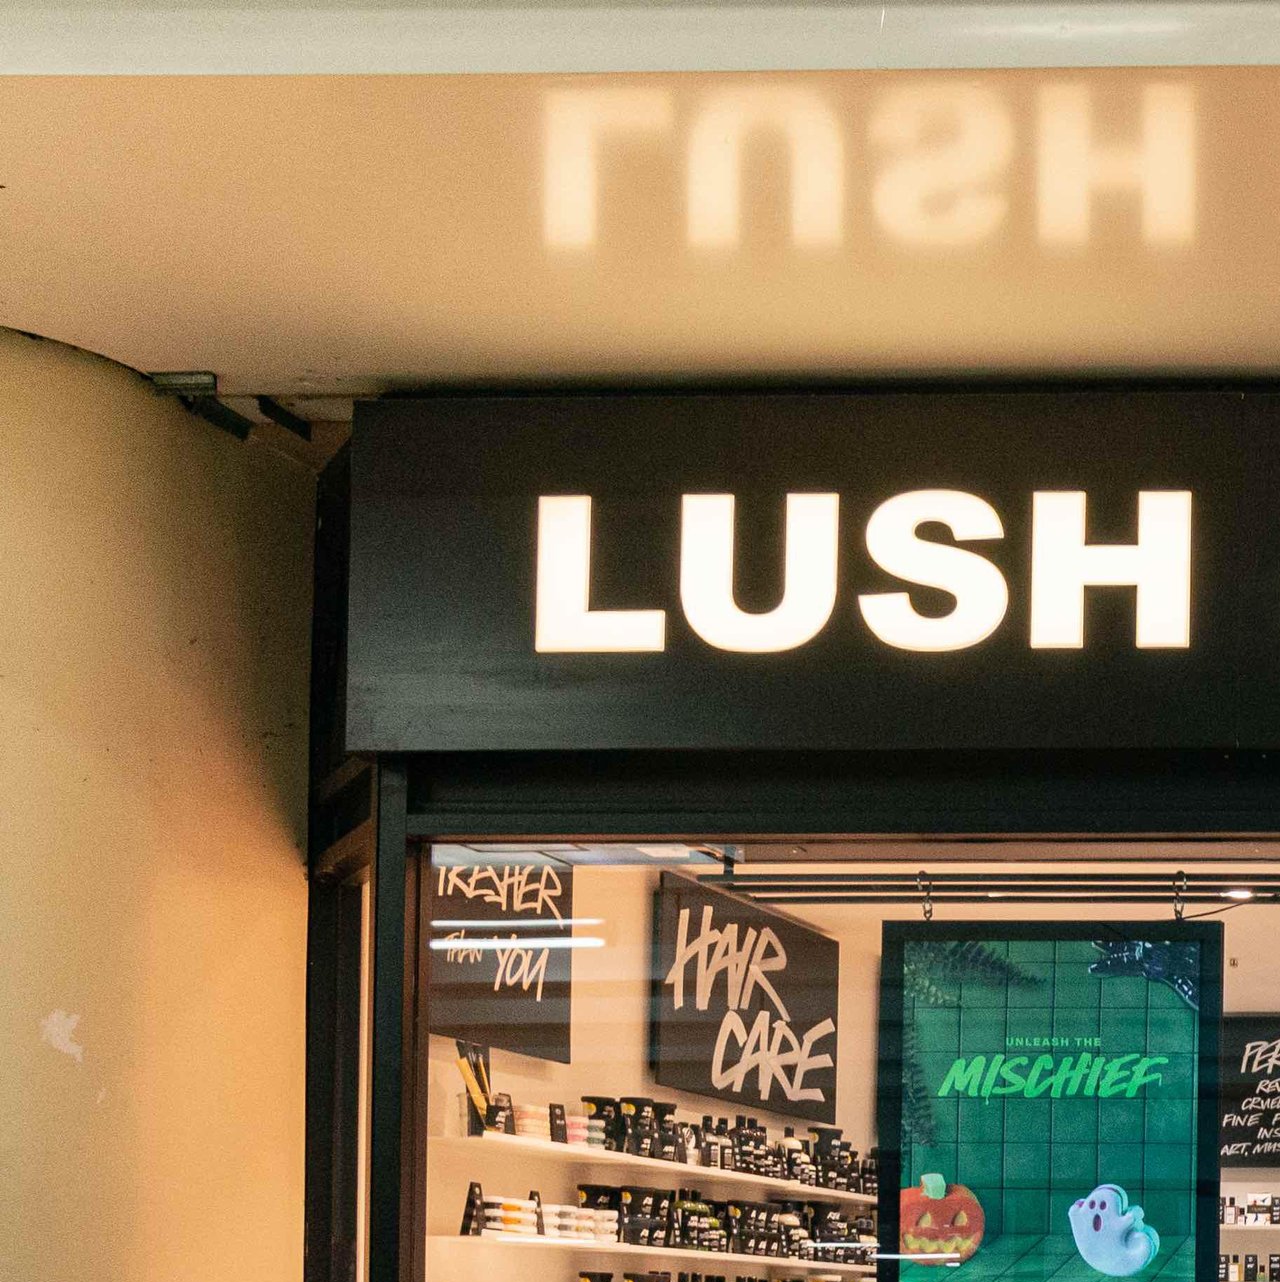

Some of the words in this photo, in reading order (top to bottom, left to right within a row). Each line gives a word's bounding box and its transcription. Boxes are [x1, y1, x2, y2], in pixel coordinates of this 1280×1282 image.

[535, 489, 1193, 653] LUSH
[493, 932, 550, 1002] YOU
[665, 905, 792, 1022] HAIR
[711, 1009, 836, 1102] CARE
[1006, 1036, 1070, 1047] UNLEASH
[1074, 1036, 1102, 1047] THE
[937, 1052, 1169, 1106] MISCHIEF
[1222, 1112, 1263, 1128] FINE
